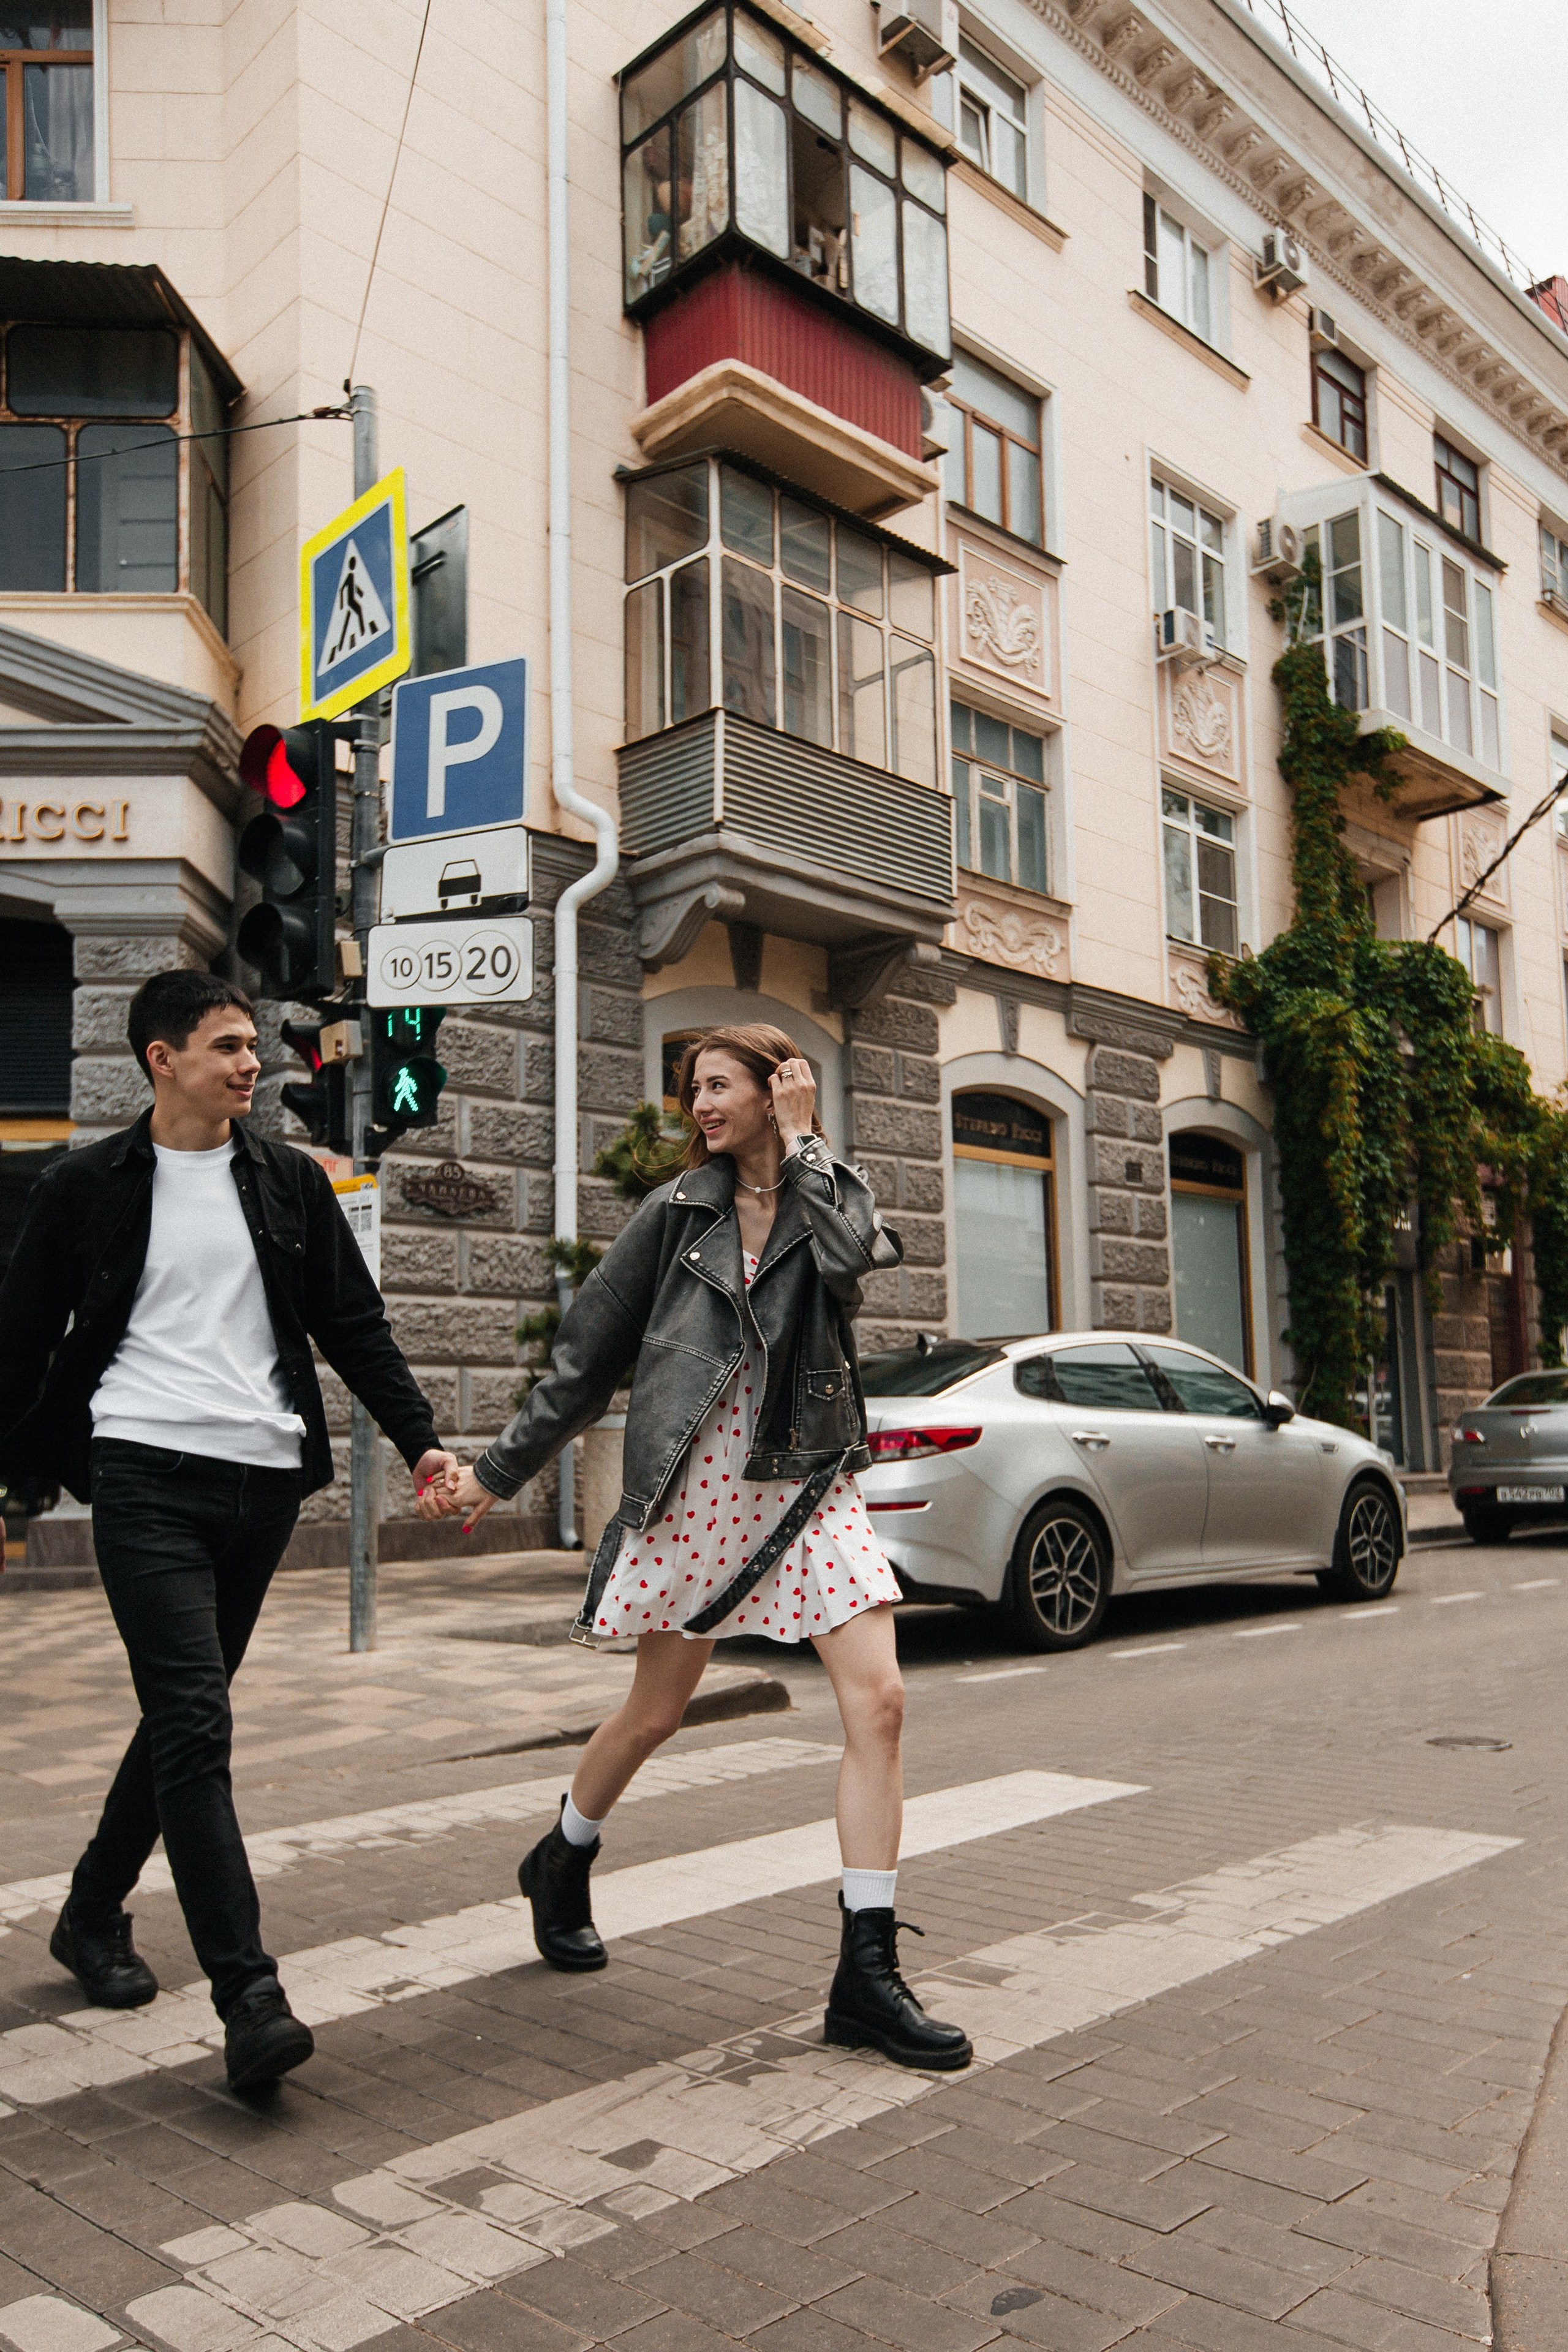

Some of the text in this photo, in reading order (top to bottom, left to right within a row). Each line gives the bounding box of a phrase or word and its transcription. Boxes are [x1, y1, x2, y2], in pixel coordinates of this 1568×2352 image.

[426, 685, 504, 819] P
[0, 797, 129, 840] ICCI
[390, 945, 511, 980] 10 15 20
[388, 1008, 421, 1041] 14
